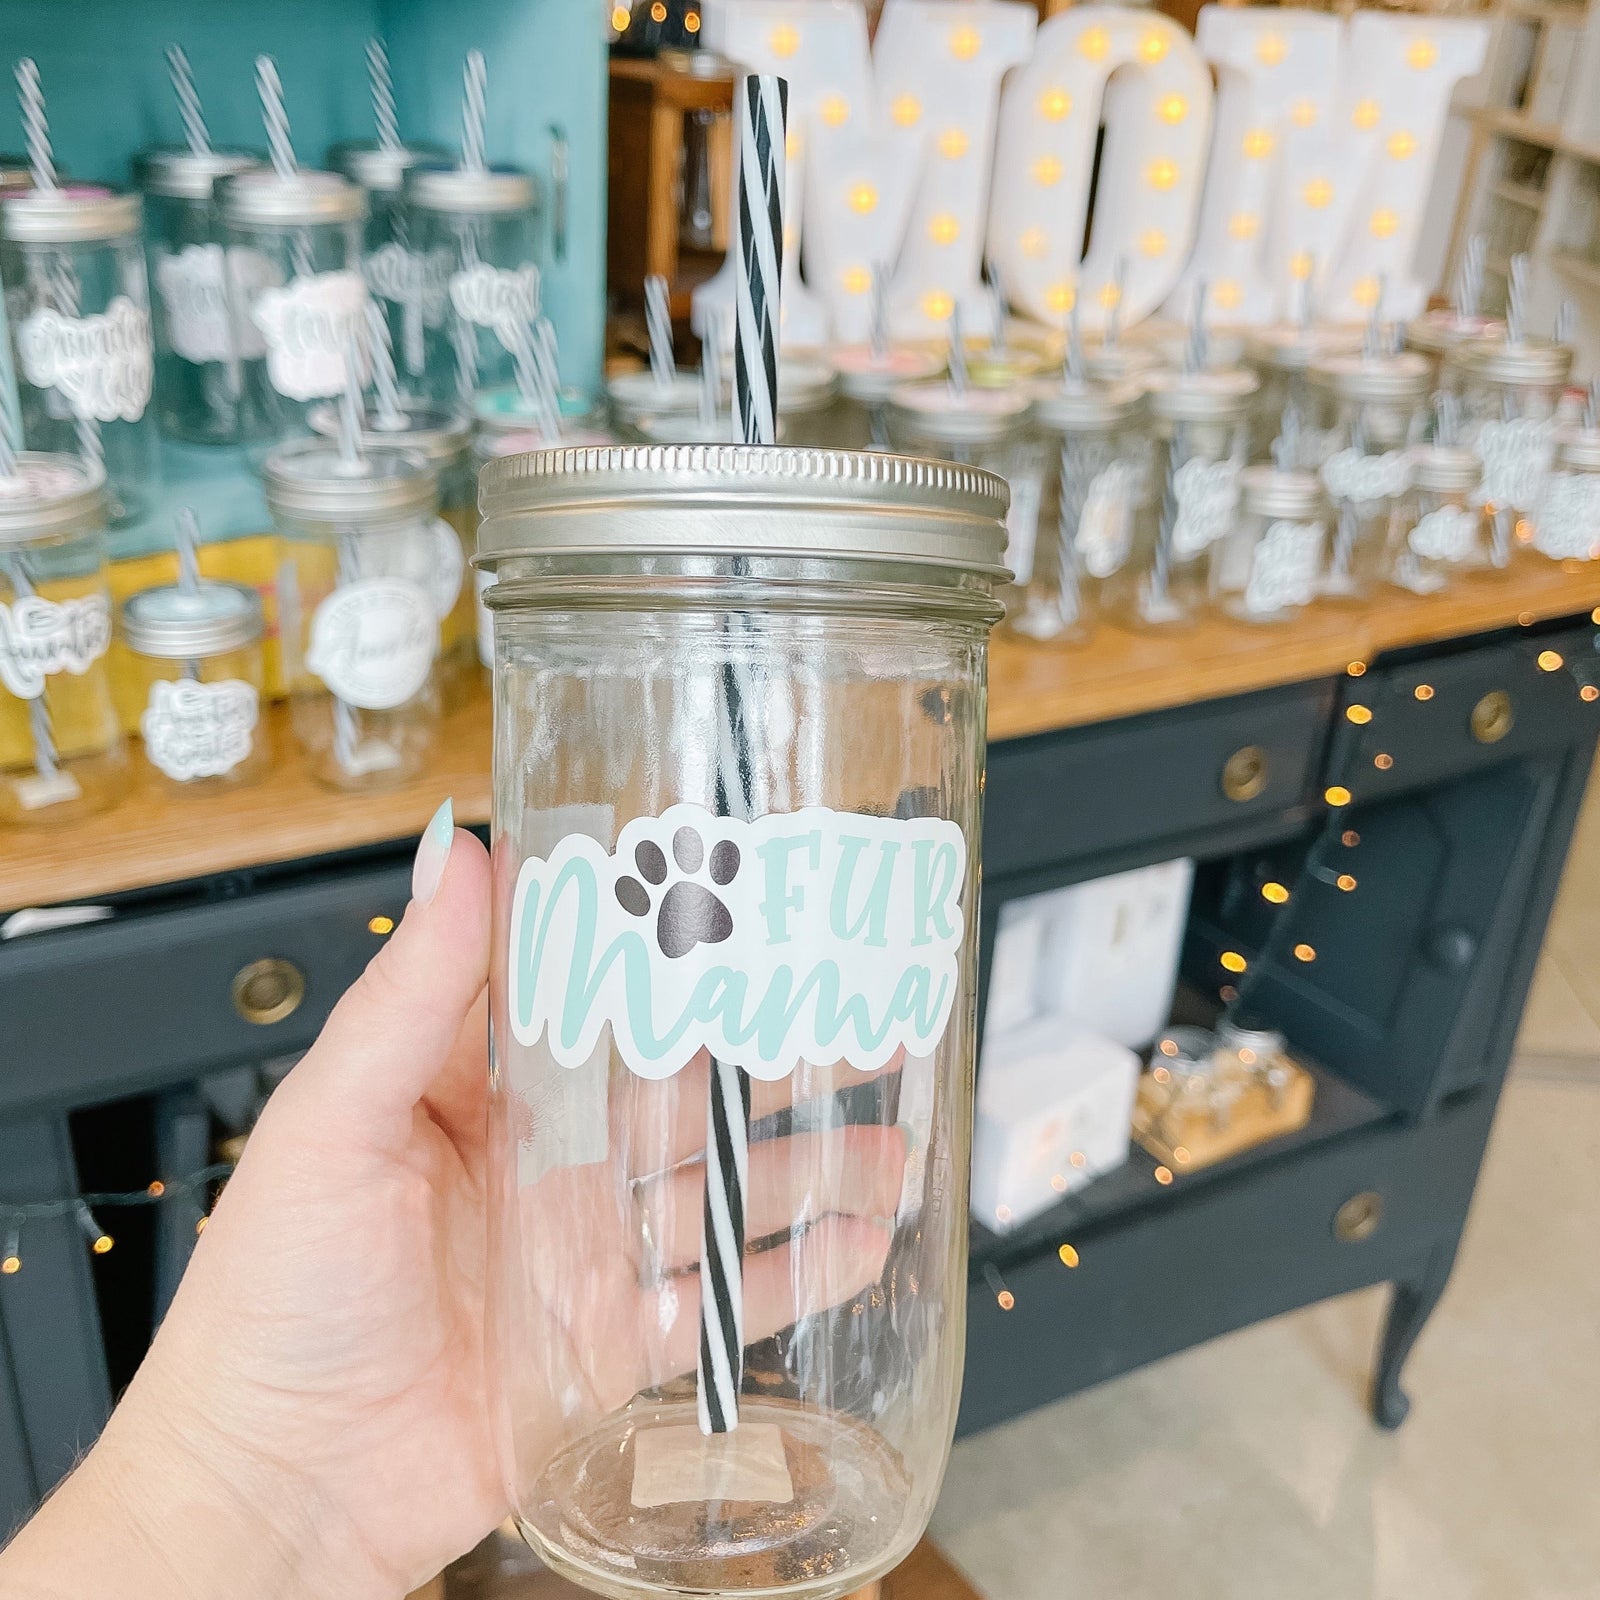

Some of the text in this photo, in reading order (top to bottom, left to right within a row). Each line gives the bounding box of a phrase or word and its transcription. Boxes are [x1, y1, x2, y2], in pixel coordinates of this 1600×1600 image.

[691, 0, 1488, 338] MOM
[518, 856, 948, 1061] Mama
[757, 830, 959, 947] FUR
